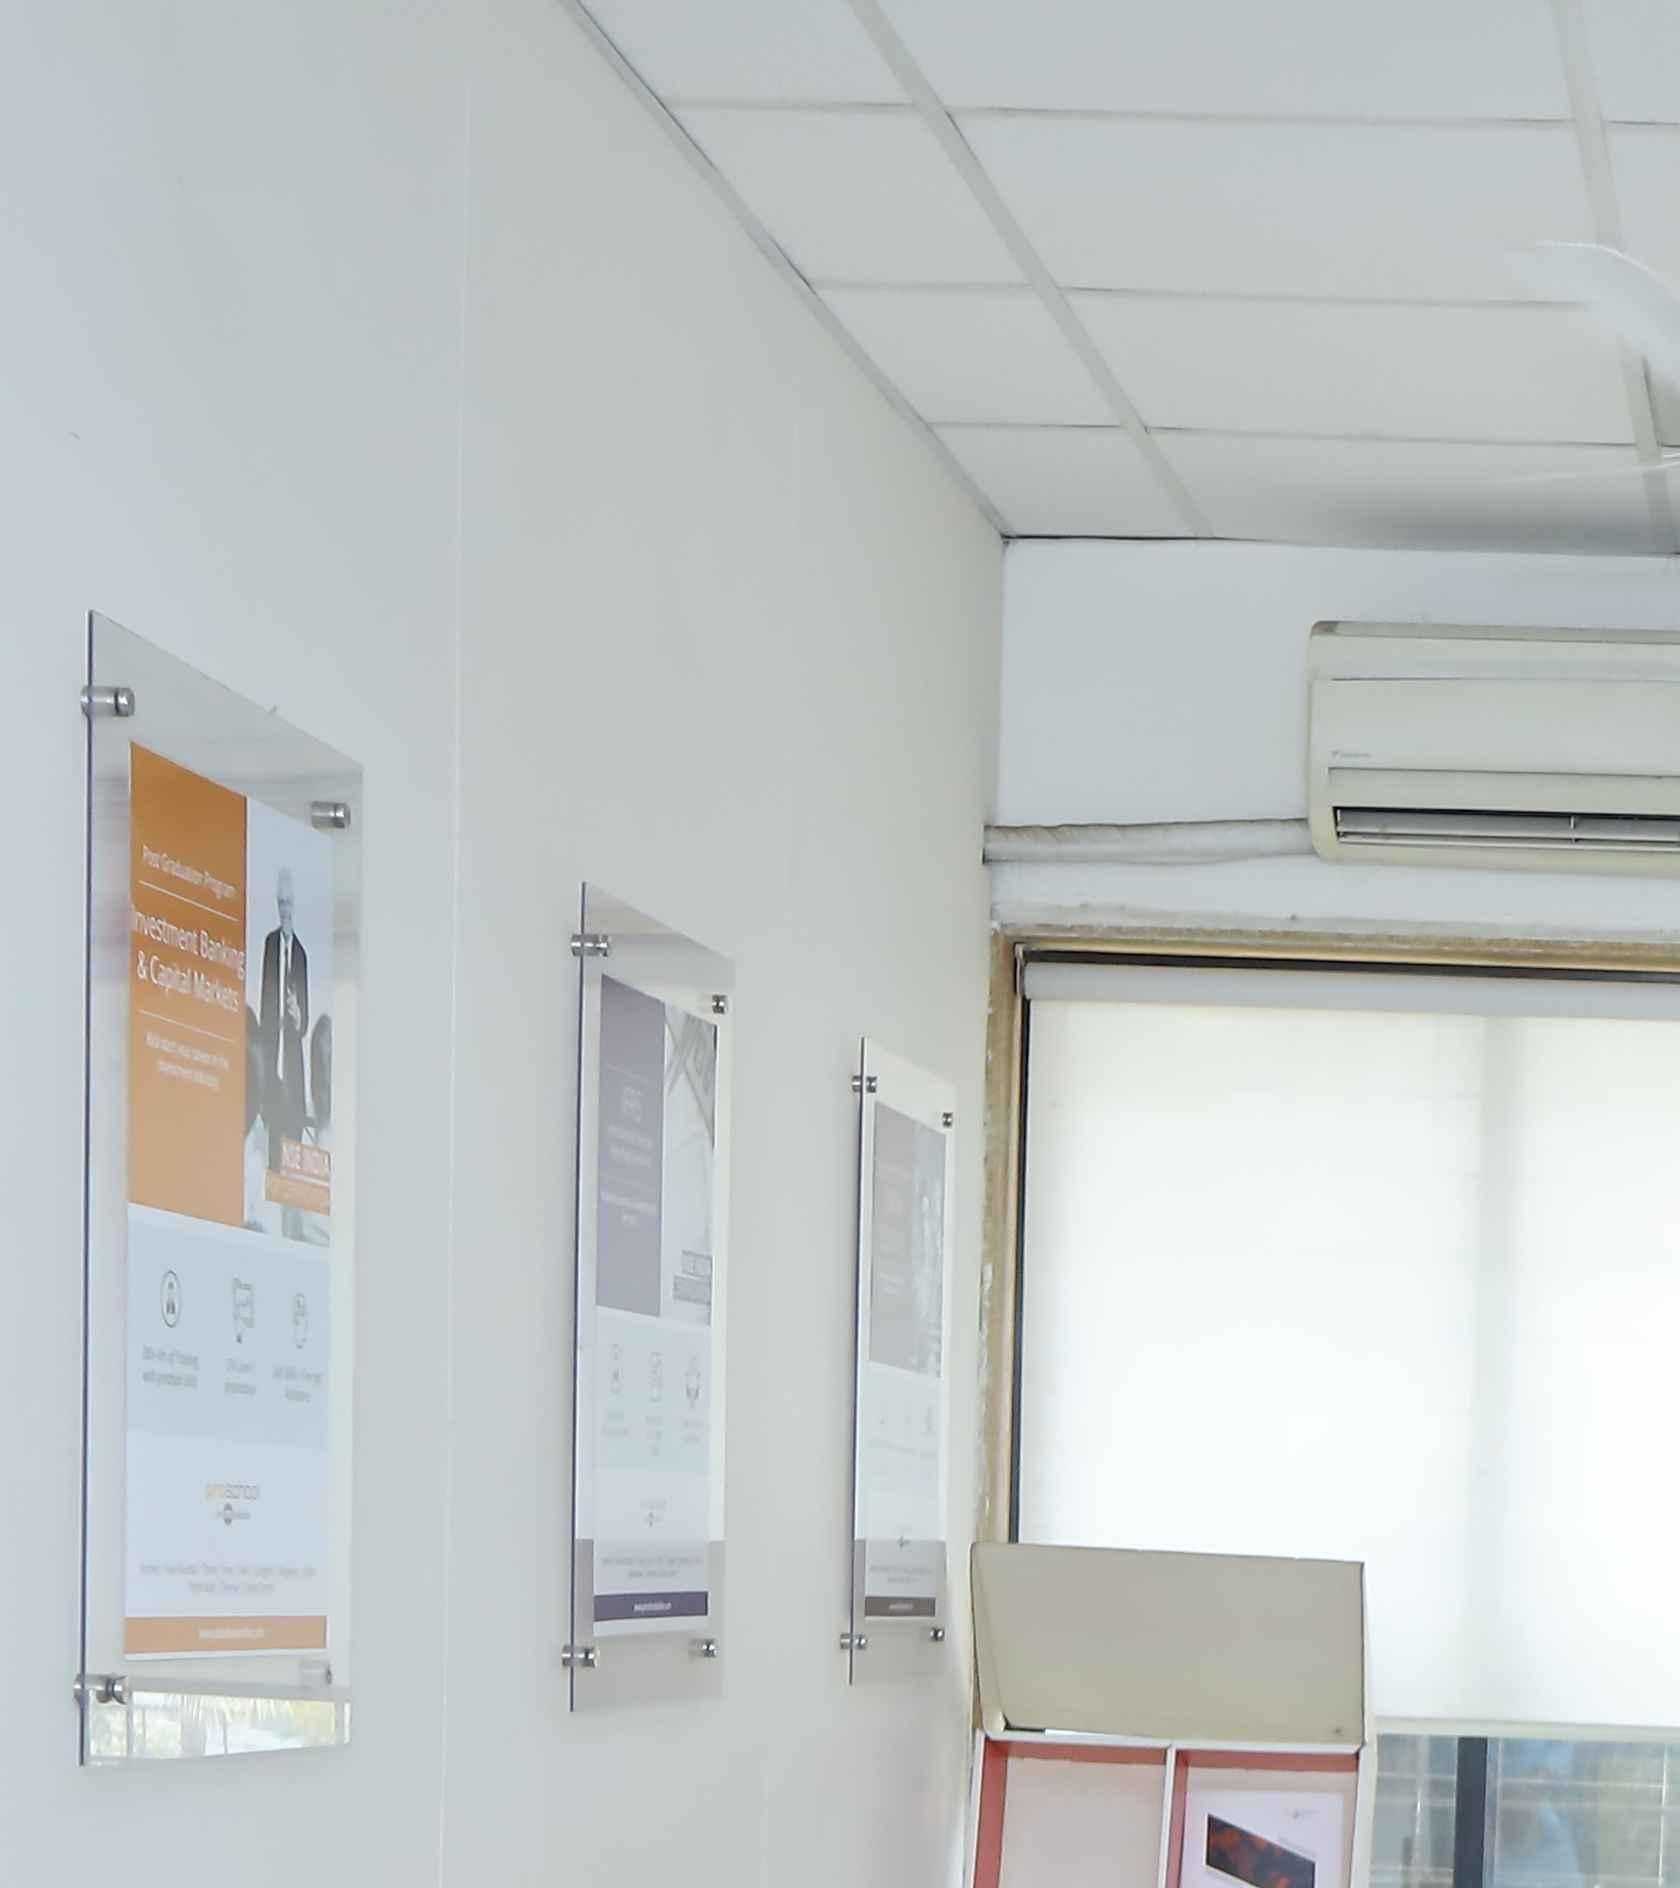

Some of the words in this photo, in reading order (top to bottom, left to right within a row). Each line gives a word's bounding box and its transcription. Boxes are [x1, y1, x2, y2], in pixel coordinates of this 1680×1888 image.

[130, 903, 199, 955] Investment
[200, 930, 246, 981] Banking
[136, 949, 148, 980] &
[150, 954, 192, 998] Capital
[193, 971, 240, 1014] Markets
